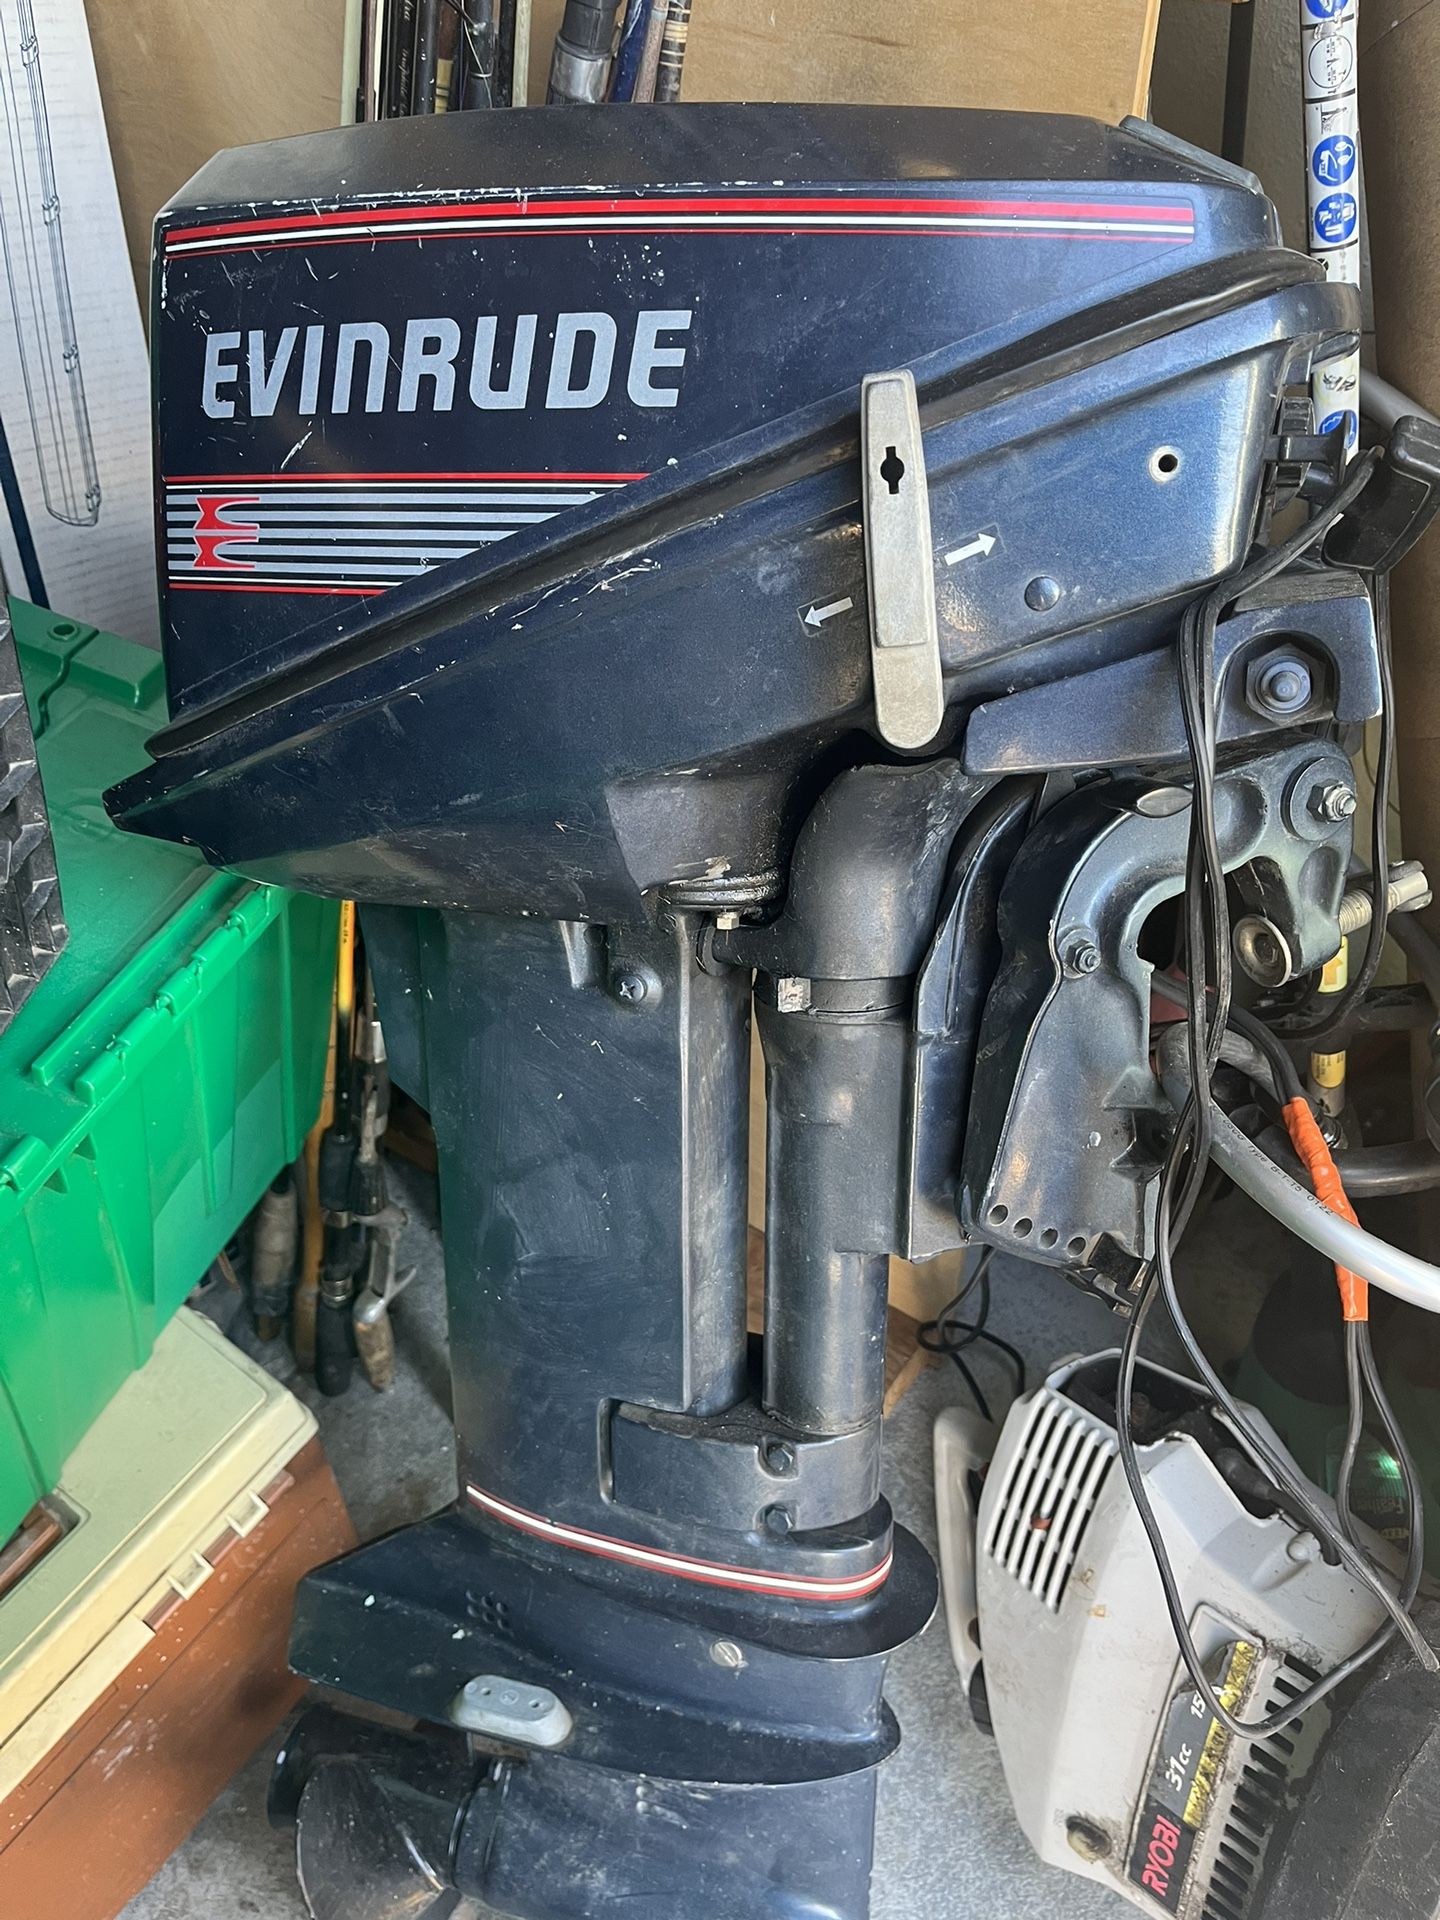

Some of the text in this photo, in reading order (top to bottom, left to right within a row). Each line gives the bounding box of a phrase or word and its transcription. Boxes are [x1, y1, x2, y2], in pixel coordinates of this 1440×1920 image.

[200, 309, 693, 420] EVINRUDE
[1141, 1814, 1182, 1897] RYOBI
[1165, 1743, 1192, 1792] 31cc
